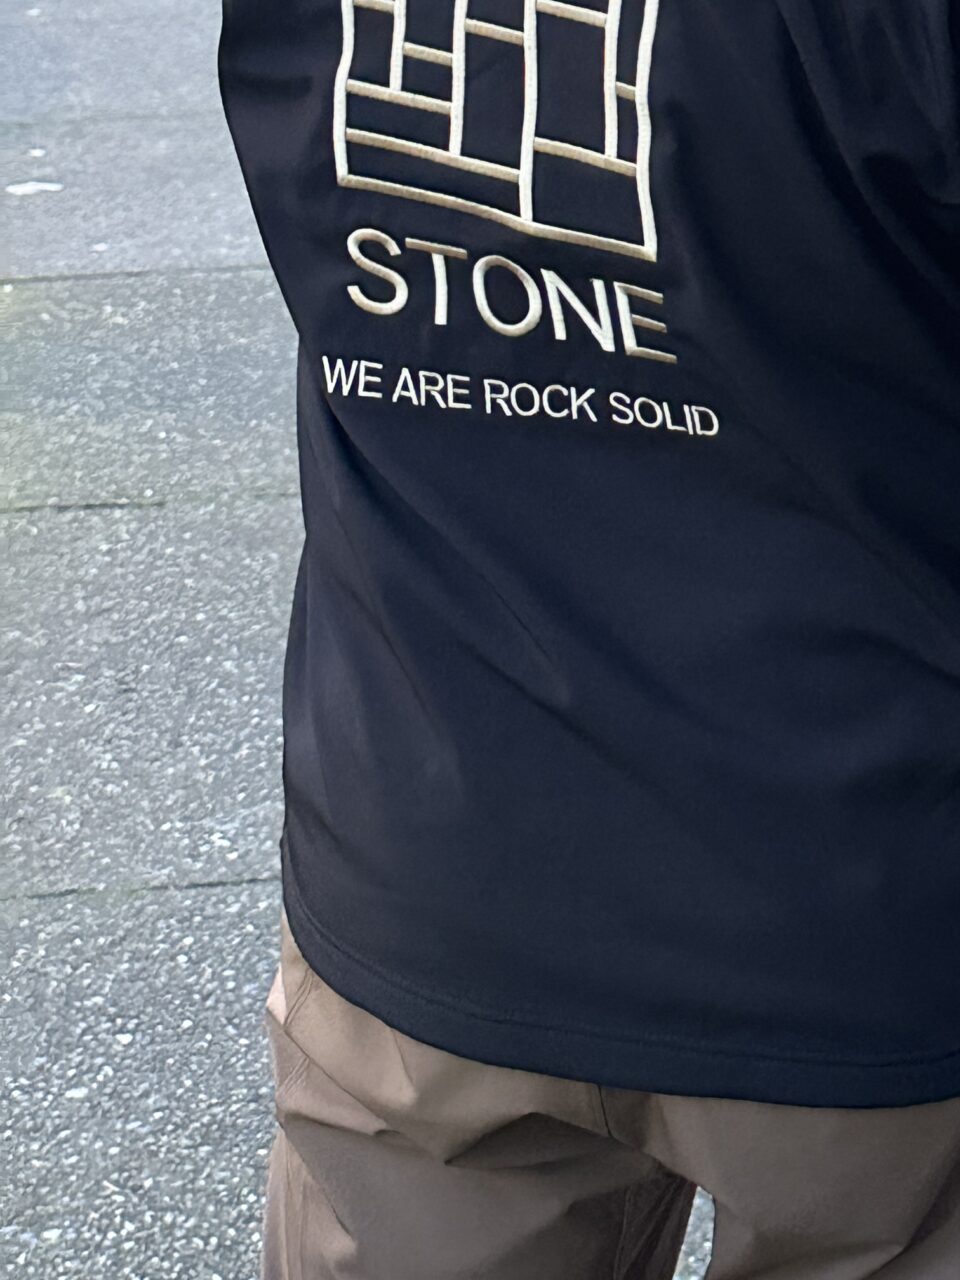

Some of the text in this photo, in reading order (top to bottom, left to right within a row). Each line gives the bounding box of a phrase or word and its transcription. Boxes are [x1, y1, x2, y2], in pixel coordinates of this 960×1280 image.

[346, 227, 678, 364] STONE
[322, 355, 720, 437] WE ARE ROCK SOLID
